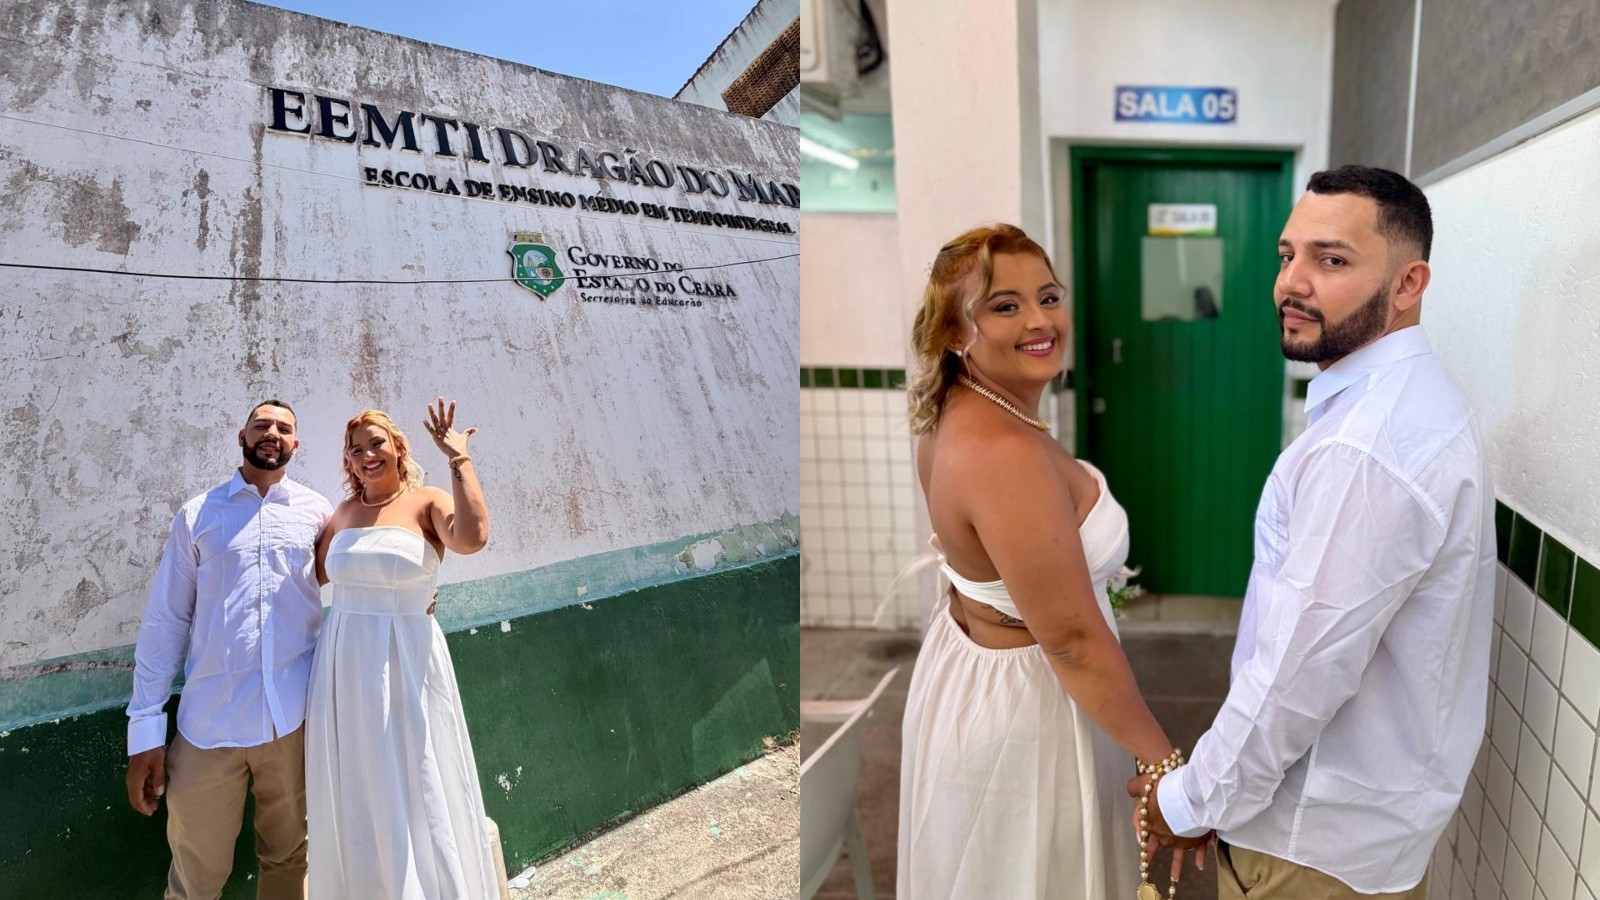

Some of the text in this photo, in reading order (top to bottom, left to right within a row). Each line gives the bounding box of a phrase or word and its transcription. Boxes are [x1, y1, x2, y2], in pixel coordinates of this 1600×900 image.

[1119, 91, 1235, 118] SALA 05
[267, 87, 490, 164] EEMTI
[494, 126, 675, 189] DRAGÃO
[677, 165, 730, 198] DO
[364, 167, 460, 196] ESCOLA
[463, 179, 495, 199] DE
[498, 184, 576, 208] ENSINO
[578, 190, 640, 216] MÉDIO
[640, 203, 670, 221] EM
[567, 245, 659, 271] GOVERNO
[572, 268, 650, 292] ESTAO
[654, 281, 676, 294] DO
